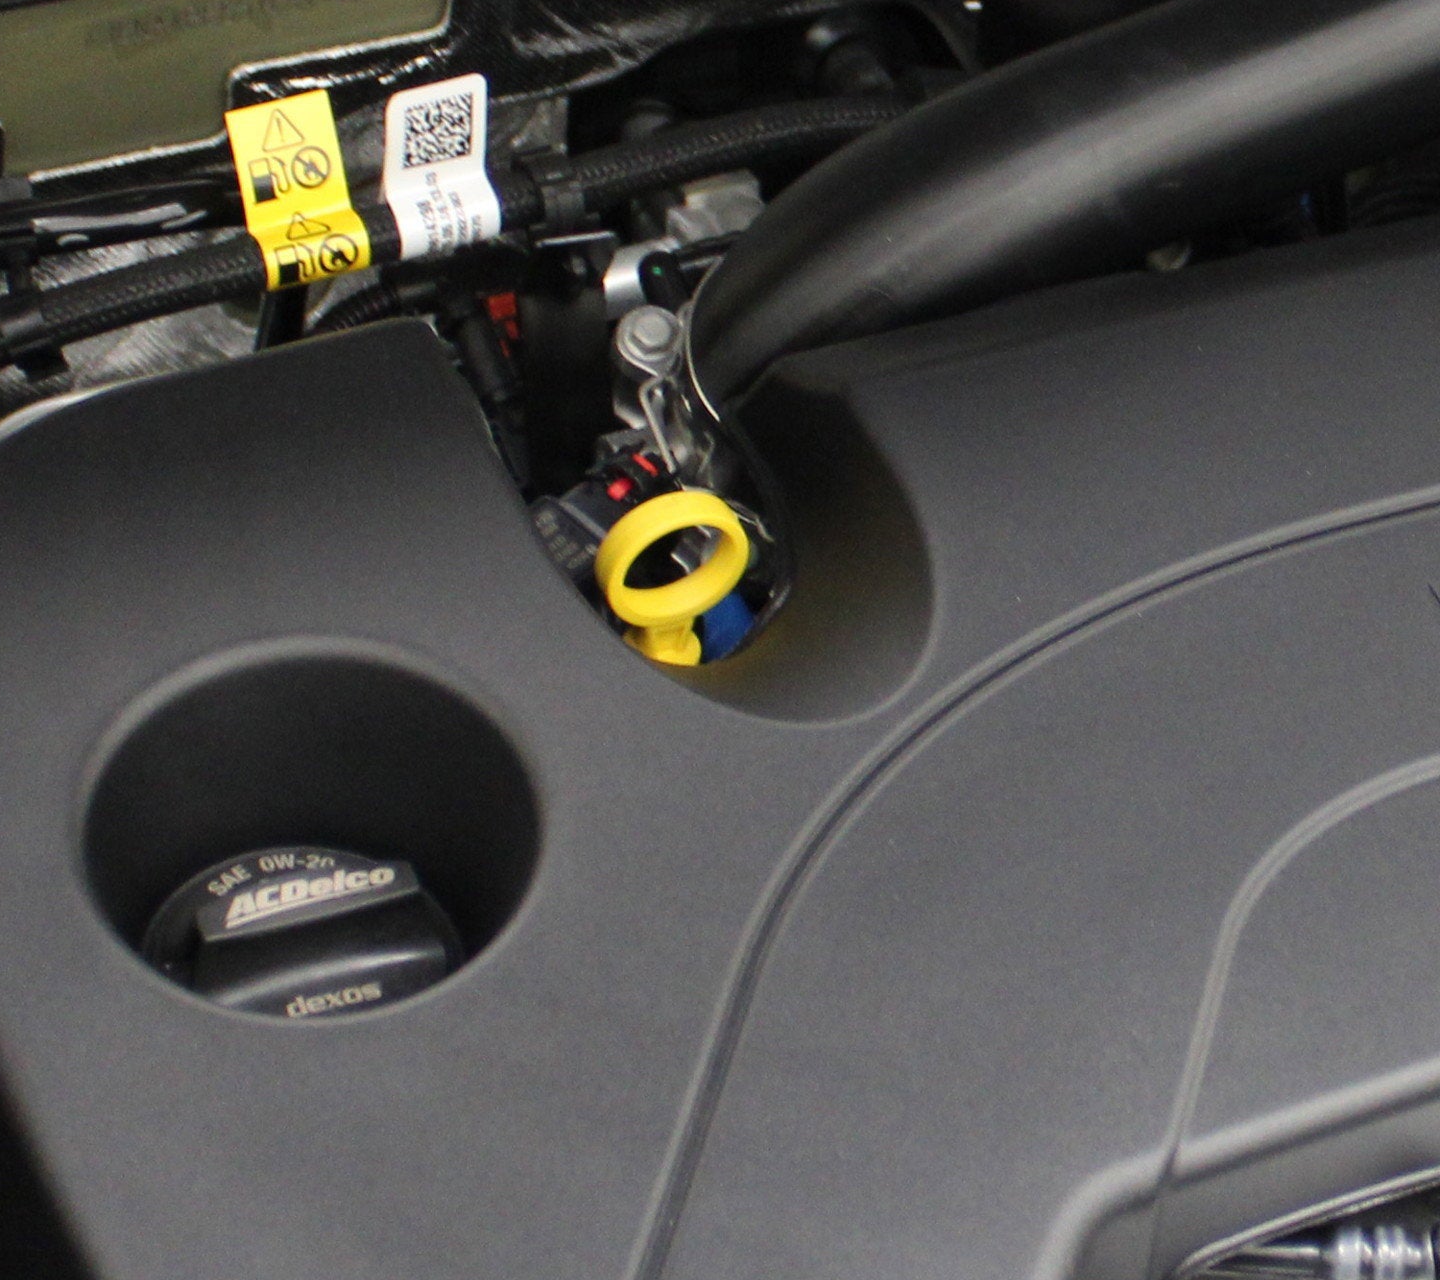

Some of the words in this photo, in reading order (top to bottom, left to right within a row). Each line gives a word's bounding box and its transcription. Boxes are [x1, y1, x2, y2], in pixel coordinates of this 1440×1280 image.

[207, 863, 252, 897] SAE
[224, 866, 395, 929] ACDelco
[285, 982, 382, 1019] dexos
